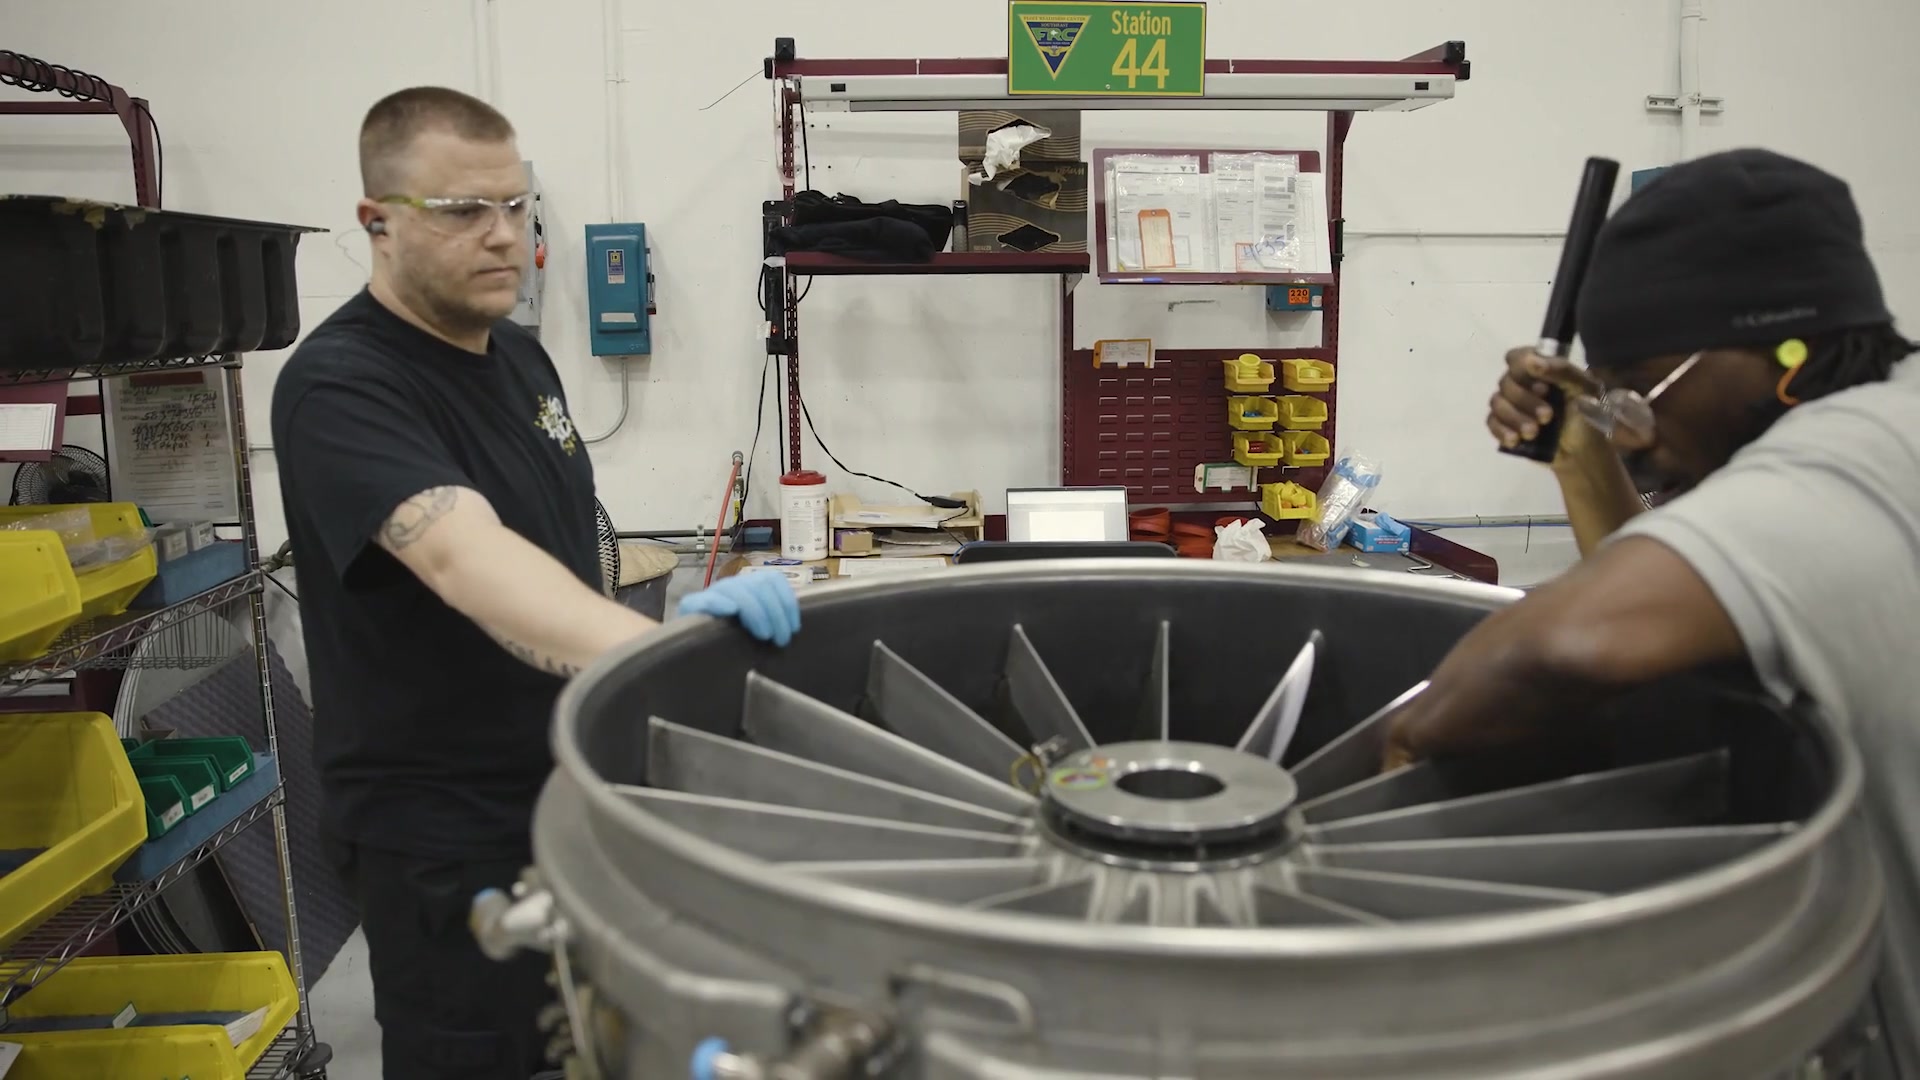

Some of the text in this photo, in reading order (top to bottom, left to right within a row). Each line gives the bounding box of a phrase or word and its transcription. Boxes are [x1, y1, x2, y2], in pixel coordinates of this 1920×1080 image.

[1111, 10, 1171, 36] Station
[1031, 27, 1080, 41] FRC
[1111, 38, 1170, 89] 44
[1290, 289, 1308, 297] 220
